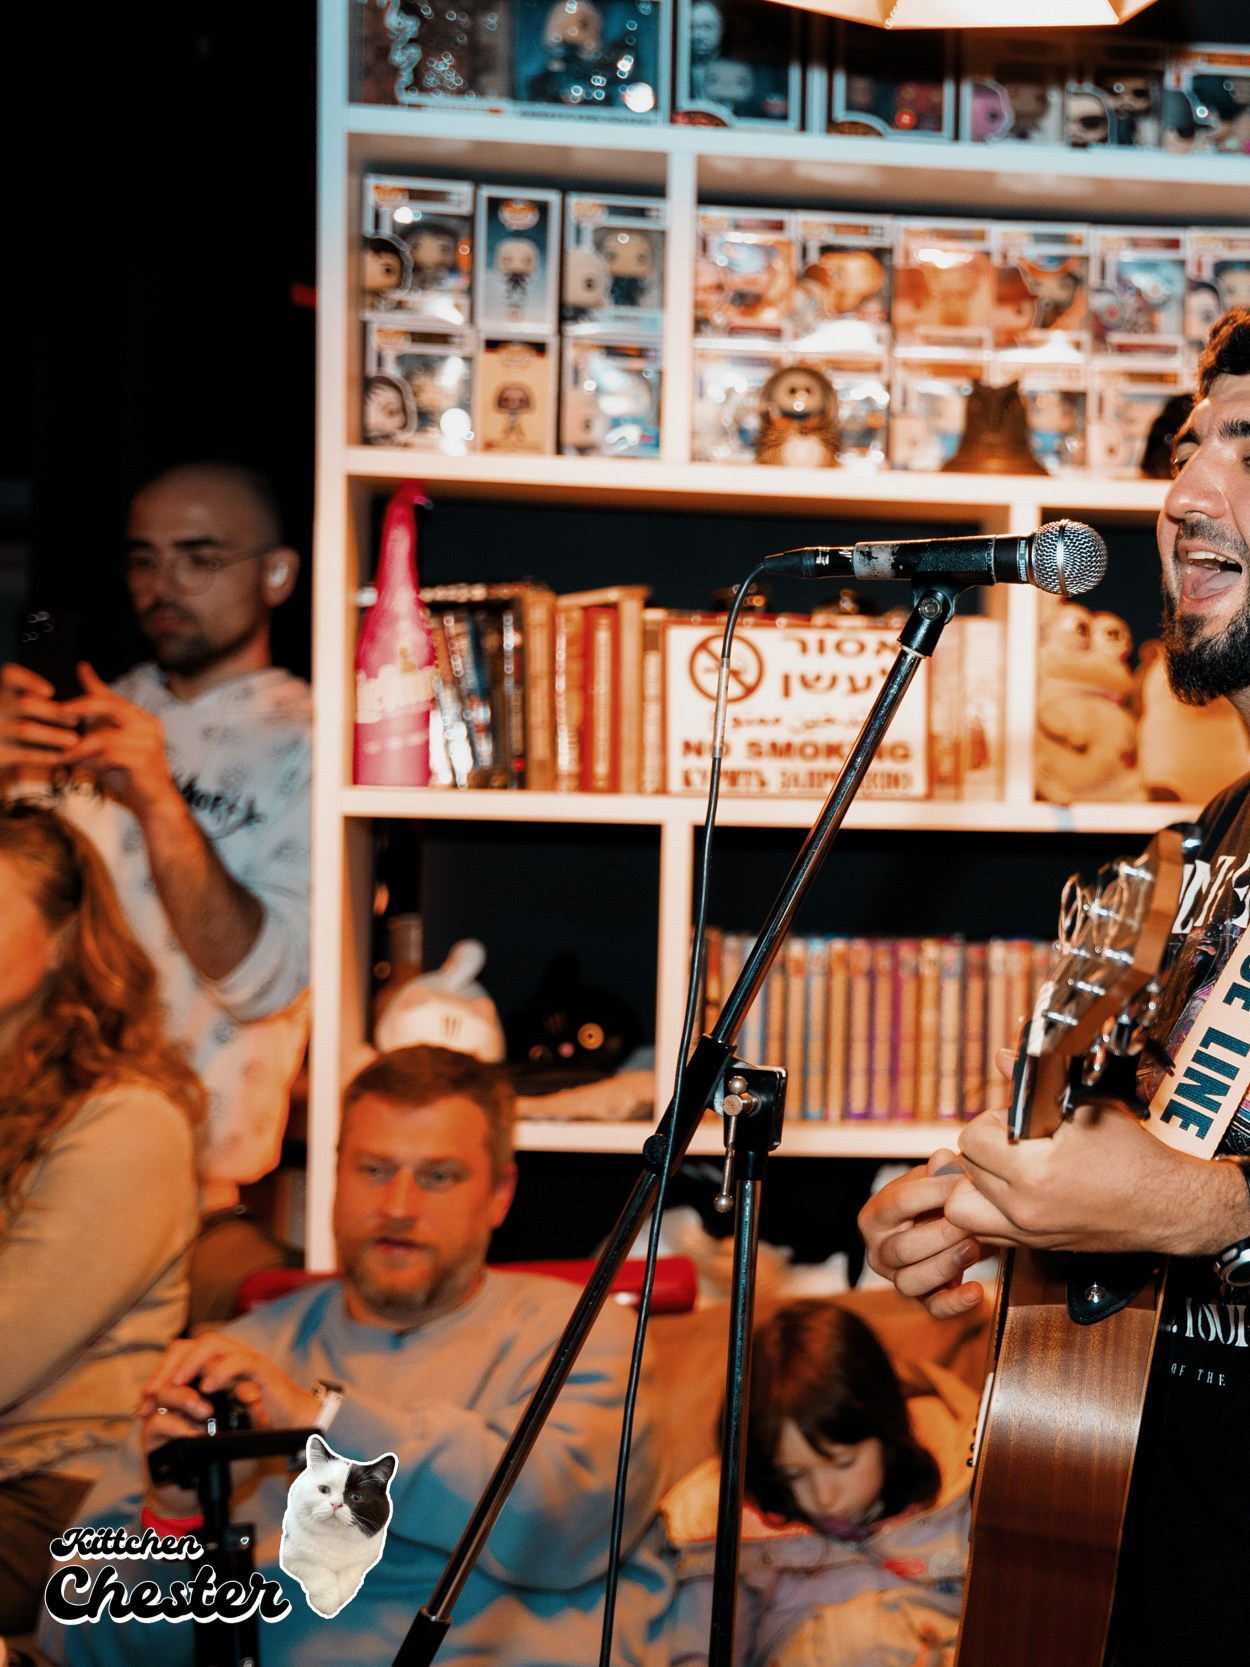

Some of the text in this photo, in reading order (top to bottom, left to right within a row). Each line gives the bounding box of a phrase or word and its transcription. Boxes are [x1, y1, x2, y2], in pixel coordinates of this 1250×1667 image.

[782, 667, 888, 699] עשן
[1171, 1362, 1187, 1377] OF
[1197, 1368, 1227, 1387] THE
